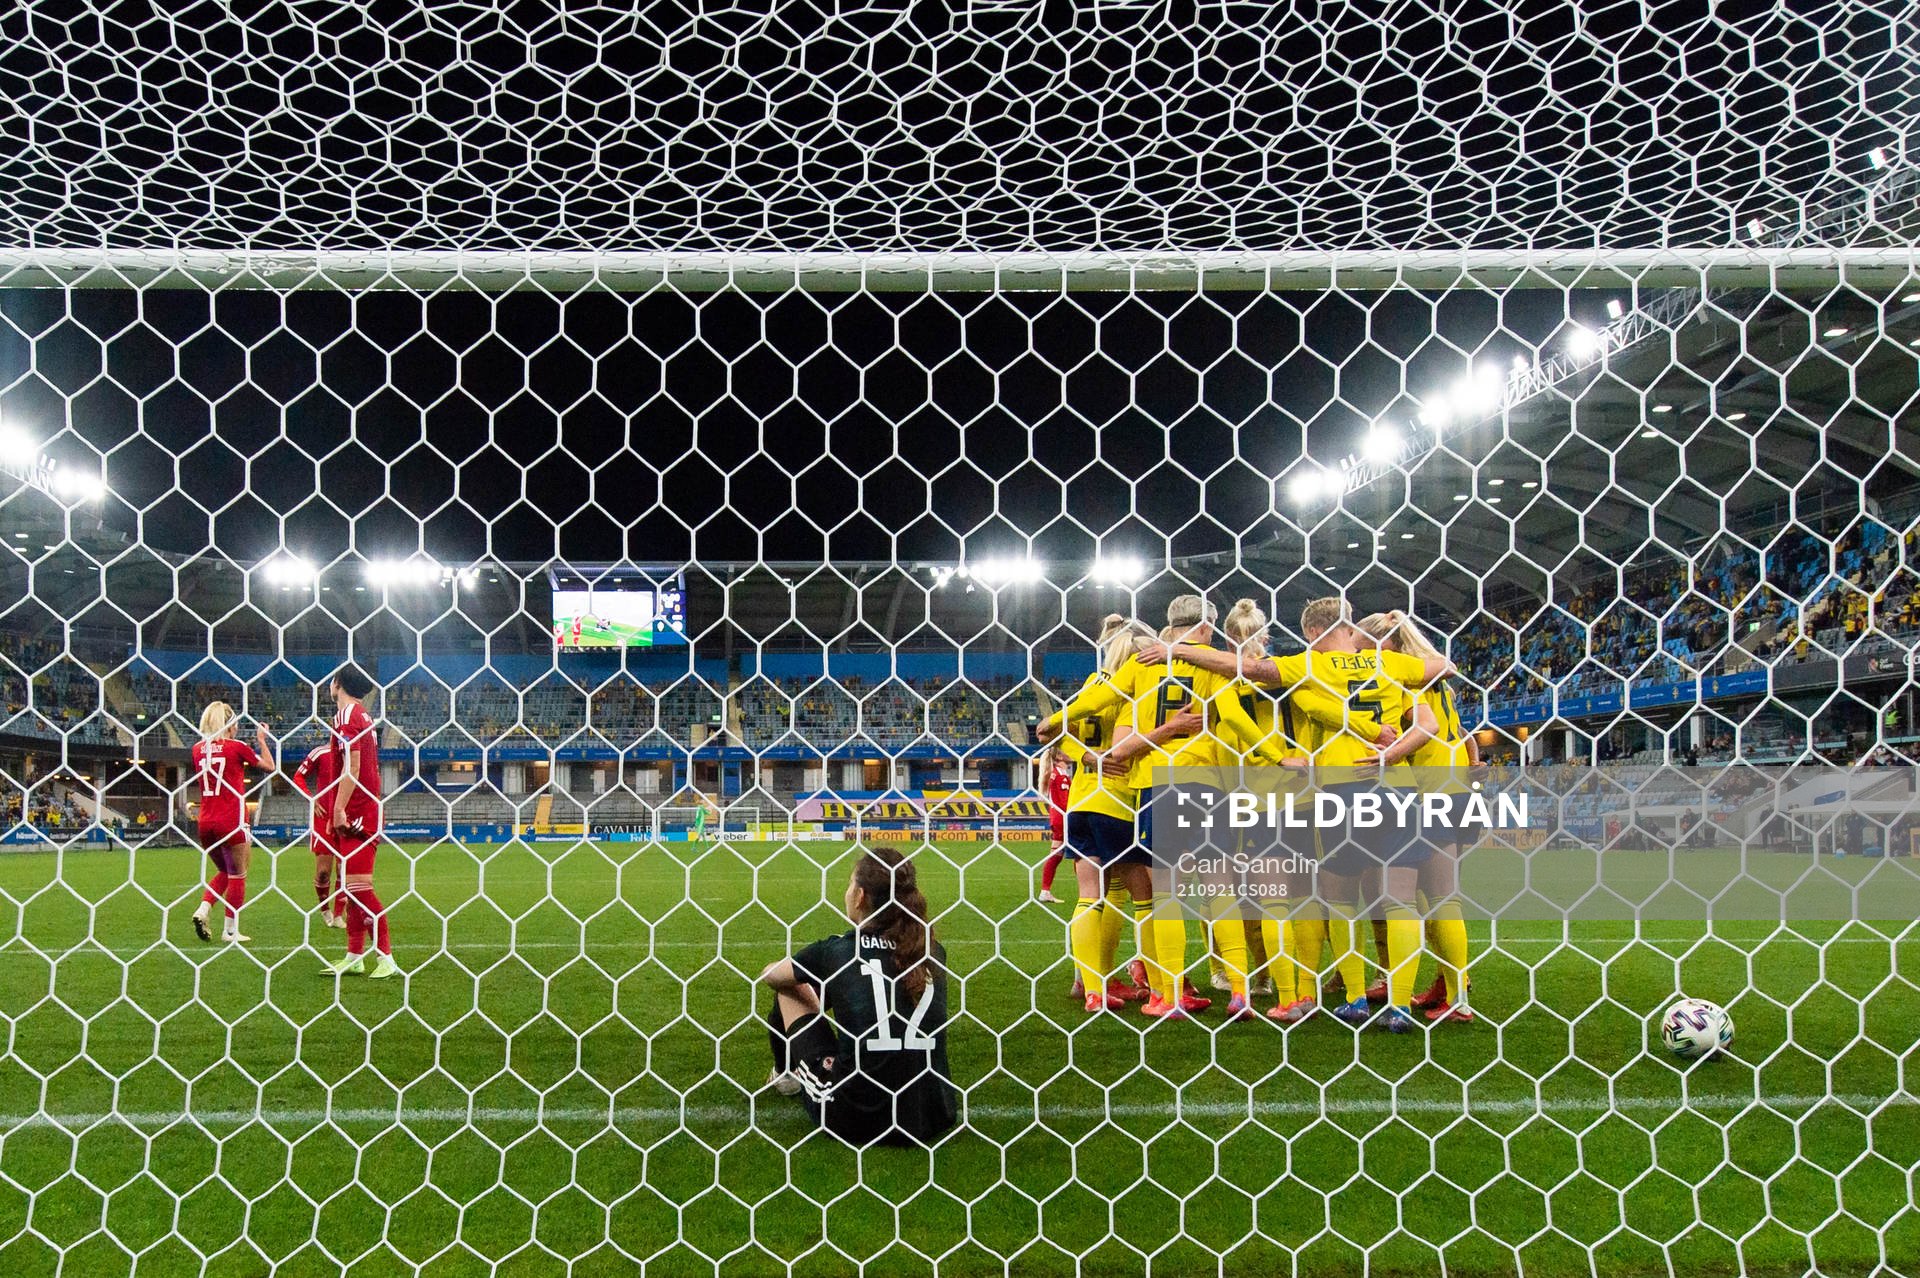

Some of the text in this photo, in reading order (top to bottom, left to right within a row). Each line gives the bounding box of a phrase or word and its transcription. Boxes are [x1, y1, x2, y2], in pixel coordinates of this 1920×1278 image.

[198, 756, 226, 797] 17
[924, 801, 1050, 818] SVERI
[860, 958, 936, 1051] 12
